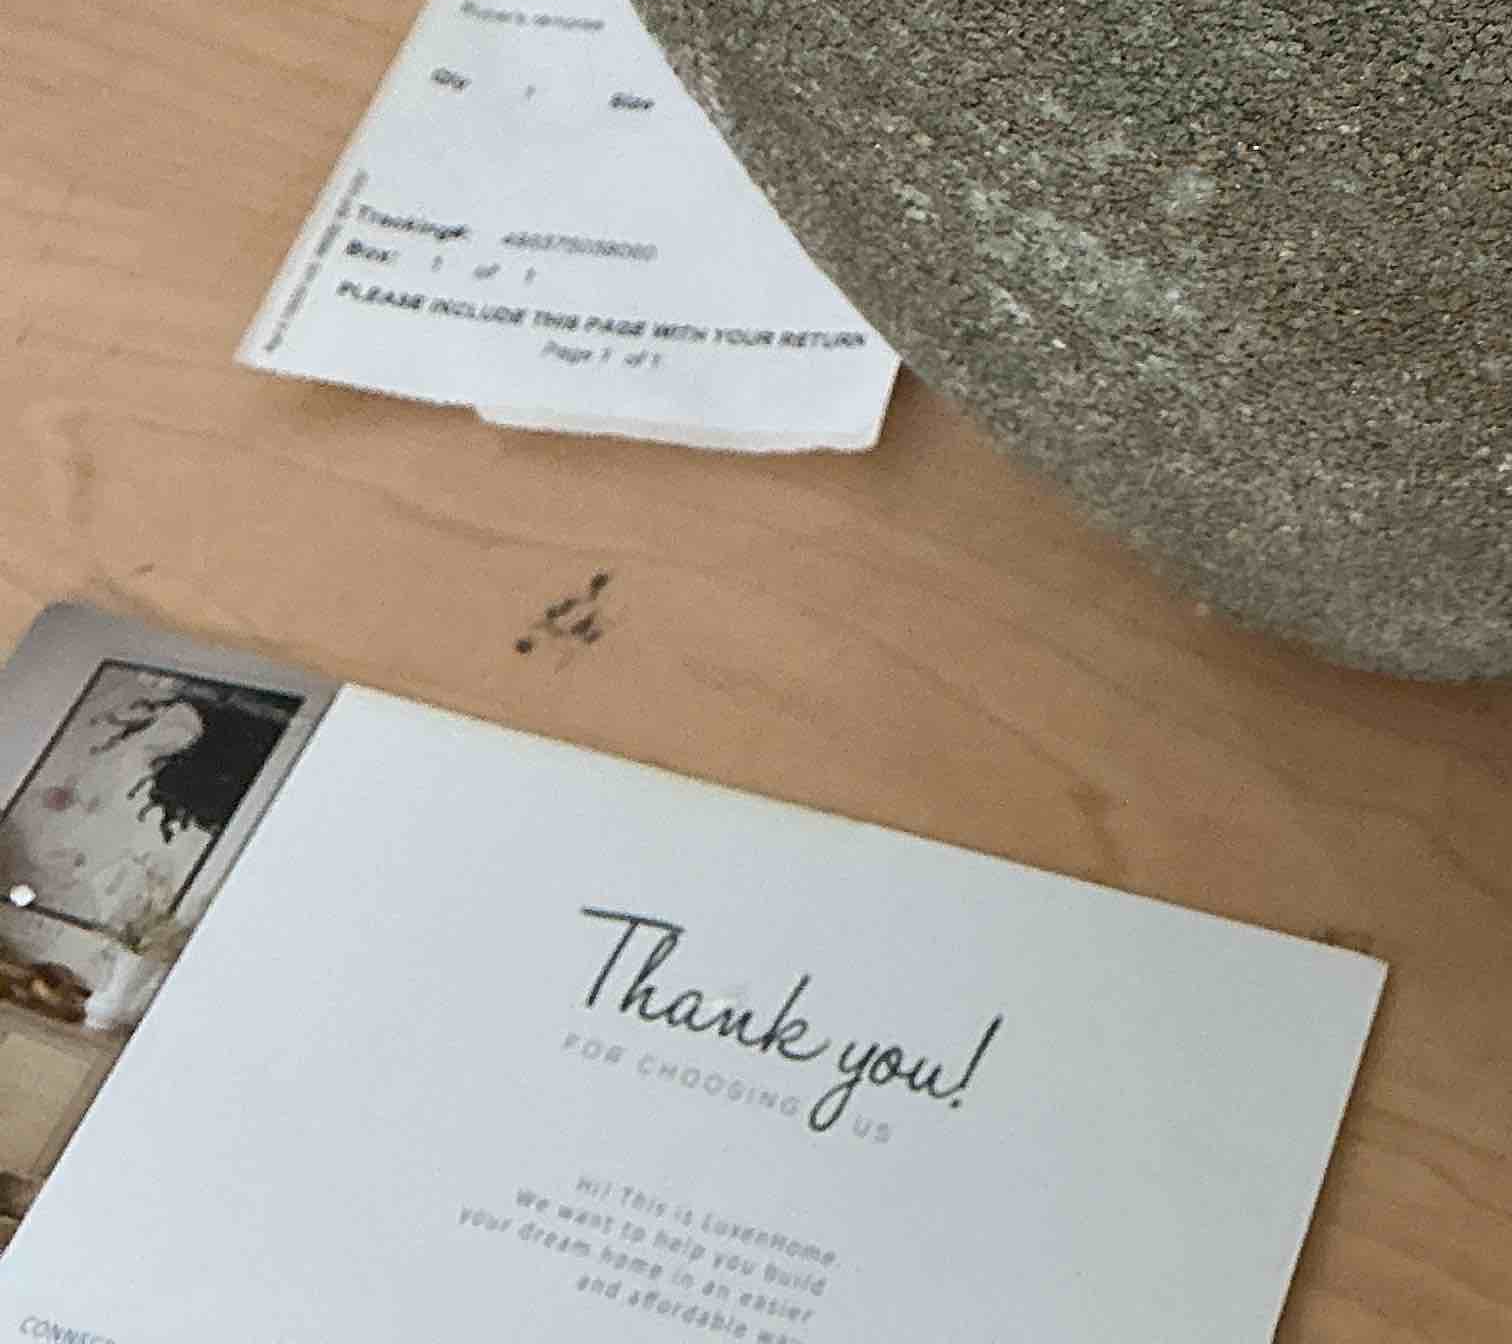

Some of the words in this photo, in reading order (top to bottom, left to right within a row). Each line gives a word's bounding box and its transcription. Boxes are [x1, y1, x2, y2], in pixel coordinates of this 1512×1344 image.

[336, 279, 428, 312] PLEASE
[427, 297, 528, 327] INCLUDE
[532, 309, 581, 332] THIS
[583, 313, 647, 337] PAGE
[652, 320, 712, 343] WITH
[711, 326, 777, 347] YOUR
[777, 330, 868, 349] RETURN
[542, 338, 595, 365] Page
[579, 905, 832, 1062] Thank
[807, 1011, 1004, 1133] you!
[561, 1031, 624, 1066] FOR
[636, 1046, 801, 1119] CHOOSING
[850, 1111, 895, 1146] US
[516, 1188, 552, 1213] We
[557, 1204, 615, 1235] want
[621, 1220, 648, 1244] to
[652, 1227, 707, 1263] help
[713, 1253, 756, 1278] you
[763, 1262, 829, 1299] build
[575, 1177, 614, 1201] Hi!
[620, 1184, 666, 1217] This
[673, 1205, 694, 1228] is
[457, 1208, 514, 1234] your
[515, 1220, 593, 1257] dream
[600, 1244, 664, 1281] home
[671, 1267, 696, 1291] in
[702, 1279, 732, 1302] an
[738, 1291, 818, 1325] easier
[575, 1275, 624, 1301] and
[627, 1290, 750, 1340] affordable
